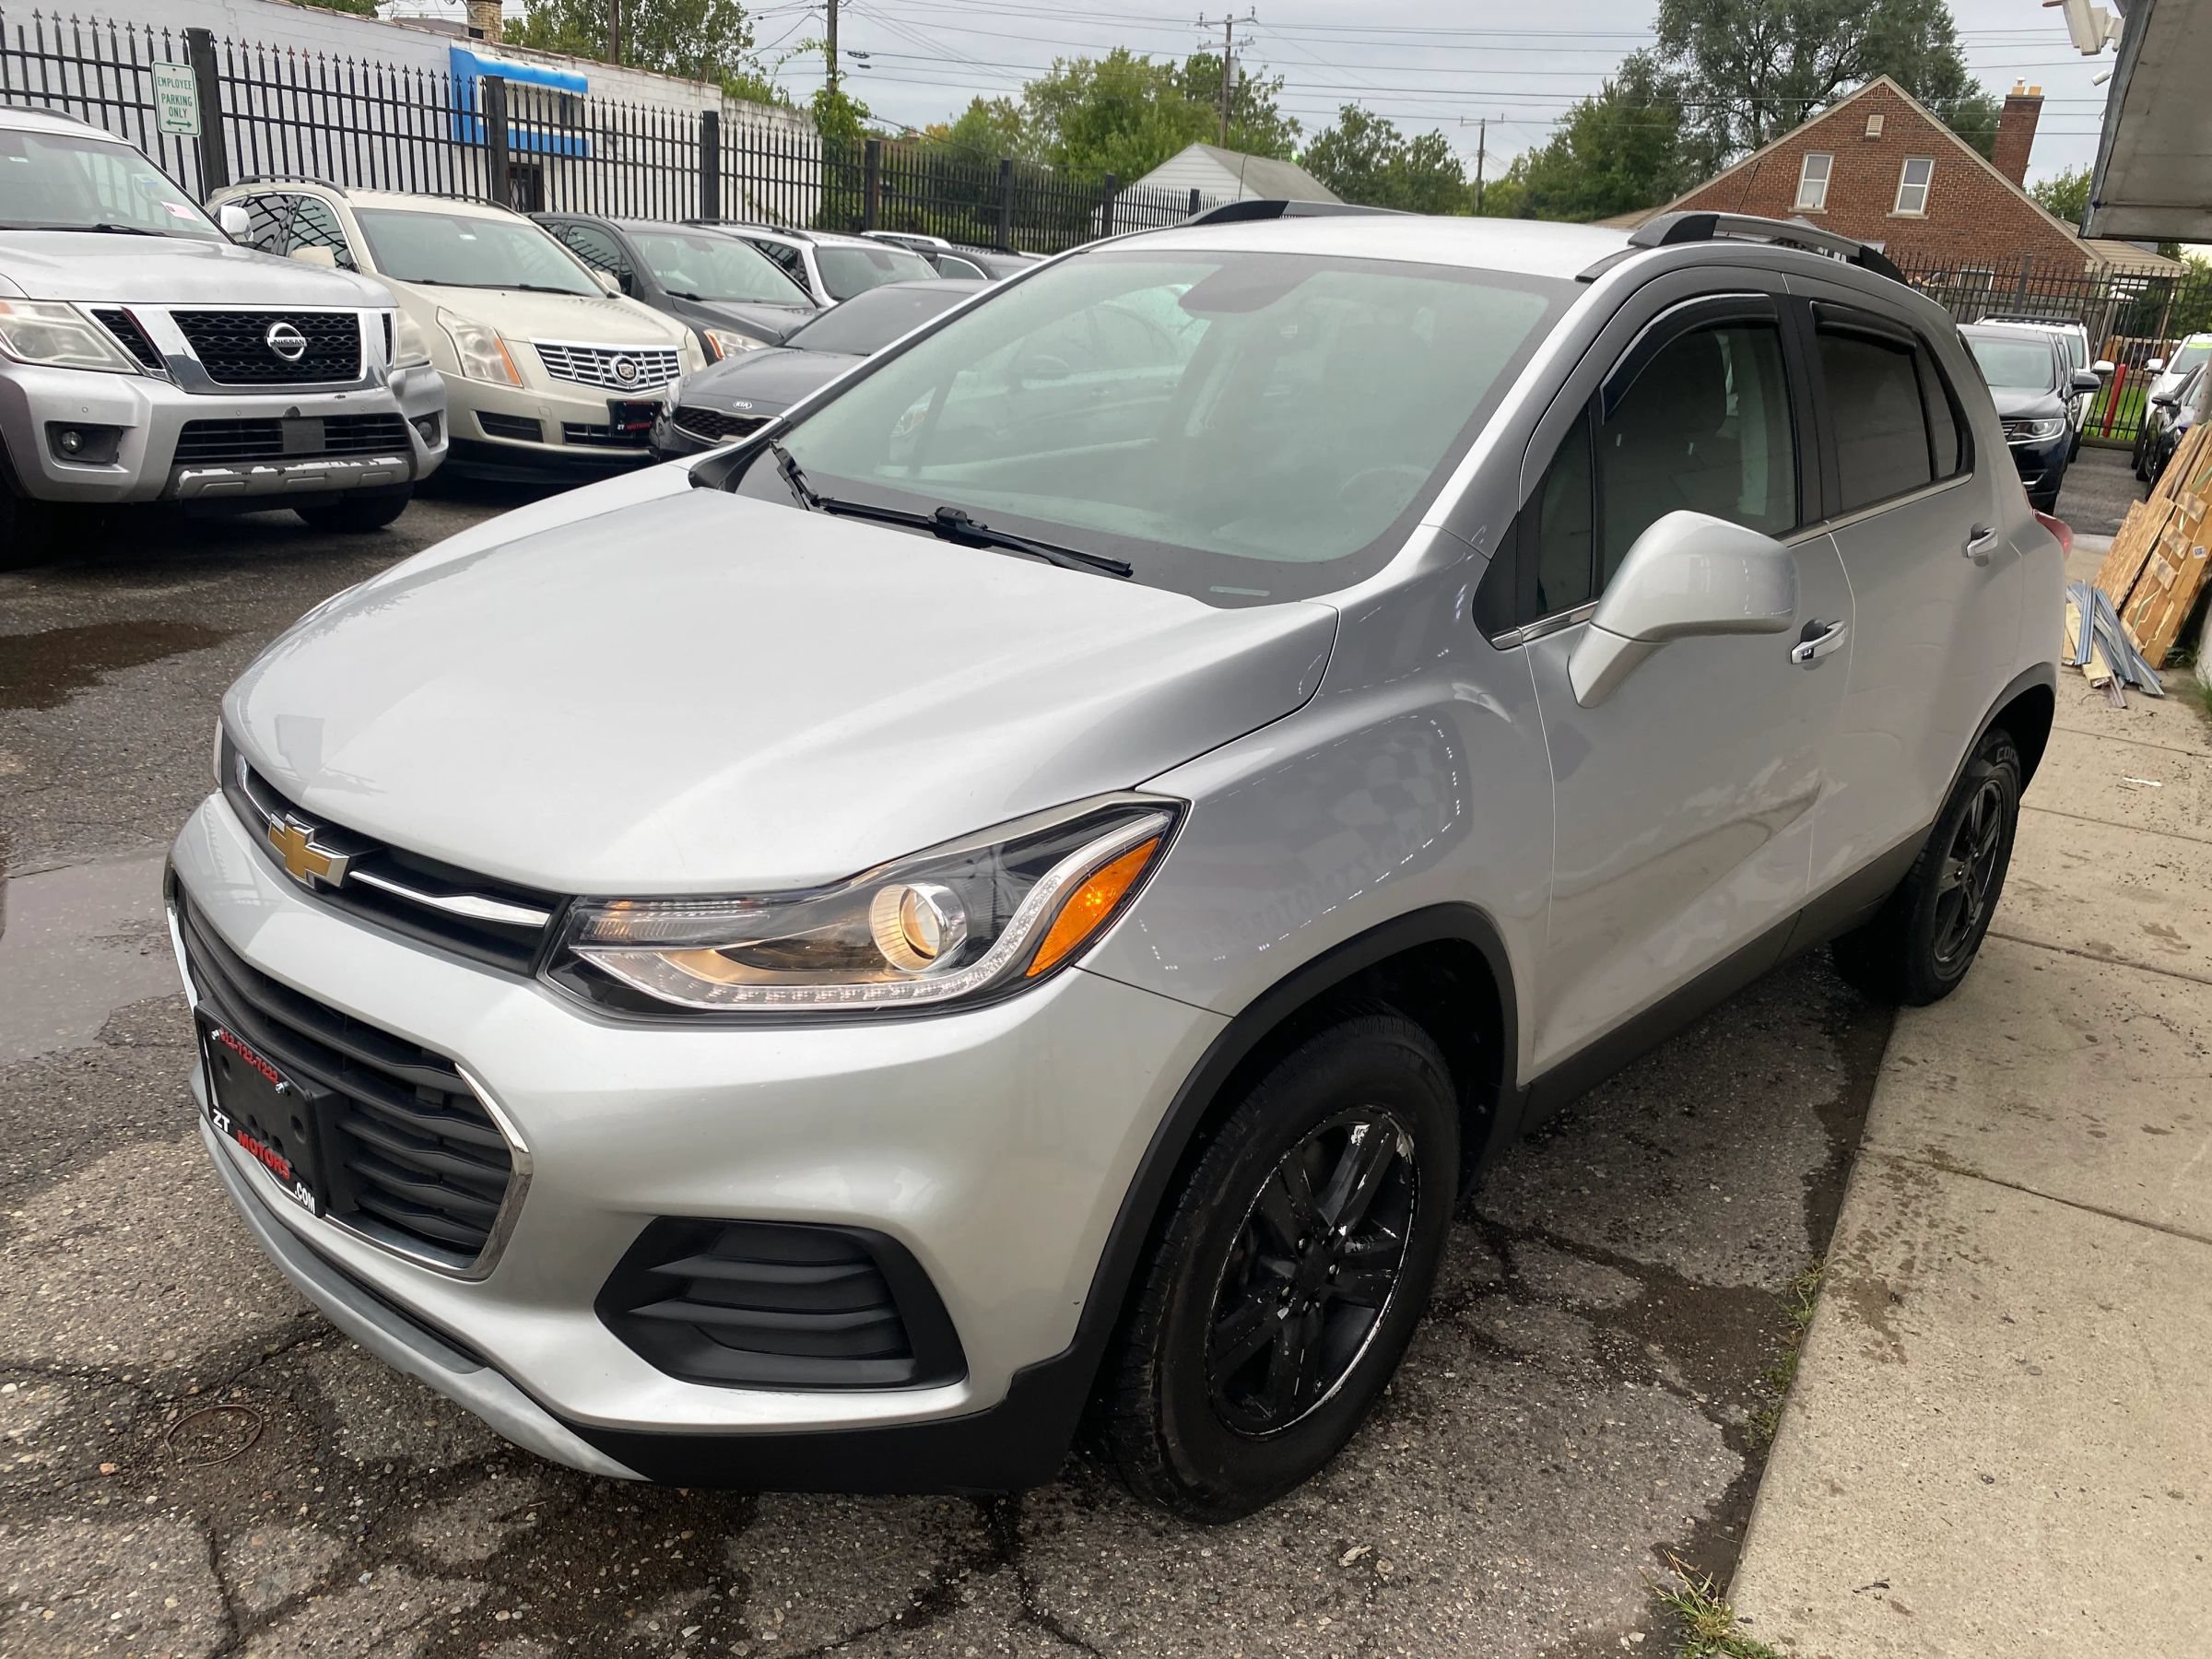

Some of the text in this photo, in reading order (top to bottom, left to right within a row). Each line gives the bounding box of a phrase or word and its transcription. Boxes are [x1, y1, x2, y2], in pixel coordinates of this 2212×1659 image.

[157, 76, 193, 90] EMPLOYEE
[161, 93, 193, 107] PARKING
[169, 106, 187, 119] ONLY
[213, 1108, 316, 1215] ZT MOTORS .COM
